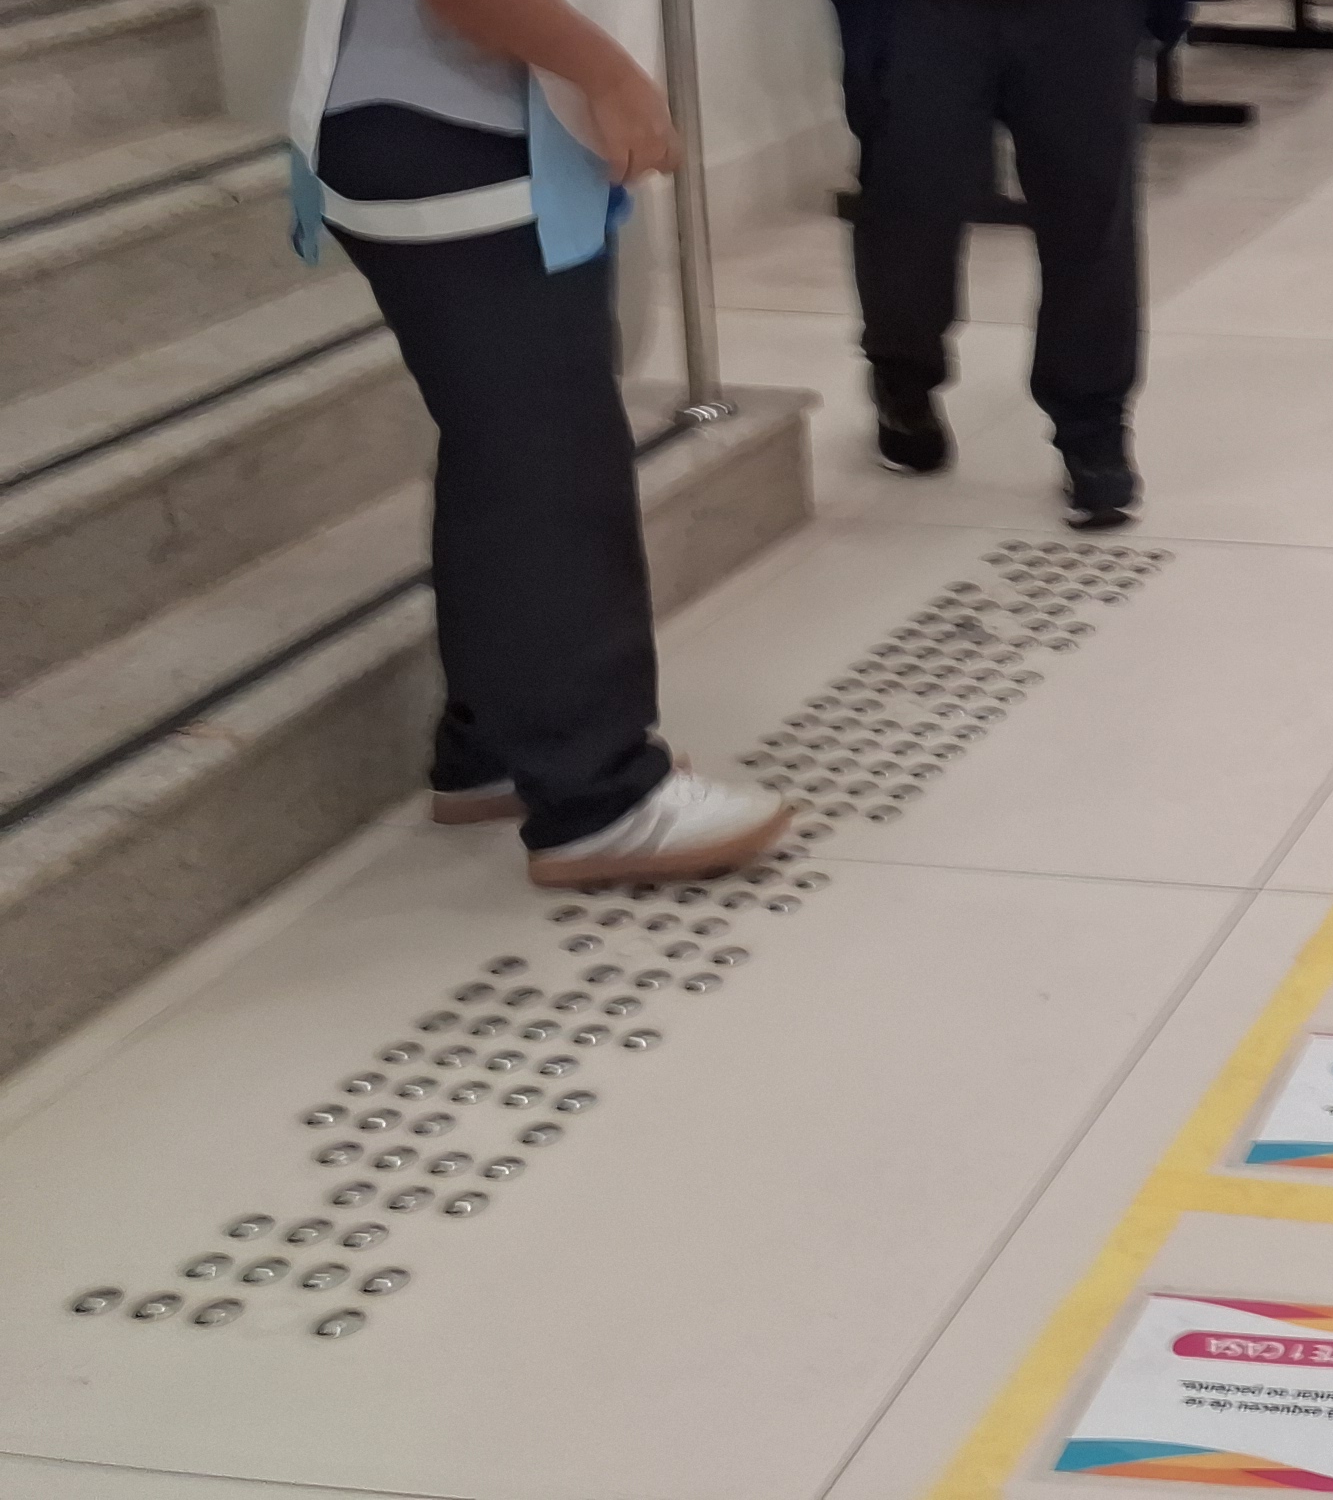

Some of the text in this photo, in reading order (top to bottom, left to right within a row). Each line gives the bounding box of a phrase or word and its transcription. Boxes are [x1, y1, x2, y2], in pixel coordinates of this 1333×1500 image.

[1205, 1338, 1285, 1359] CASA
[1289, 1344, 1304, 1361] 1
[1238, 1401, 1322, 1417] esqueceu
